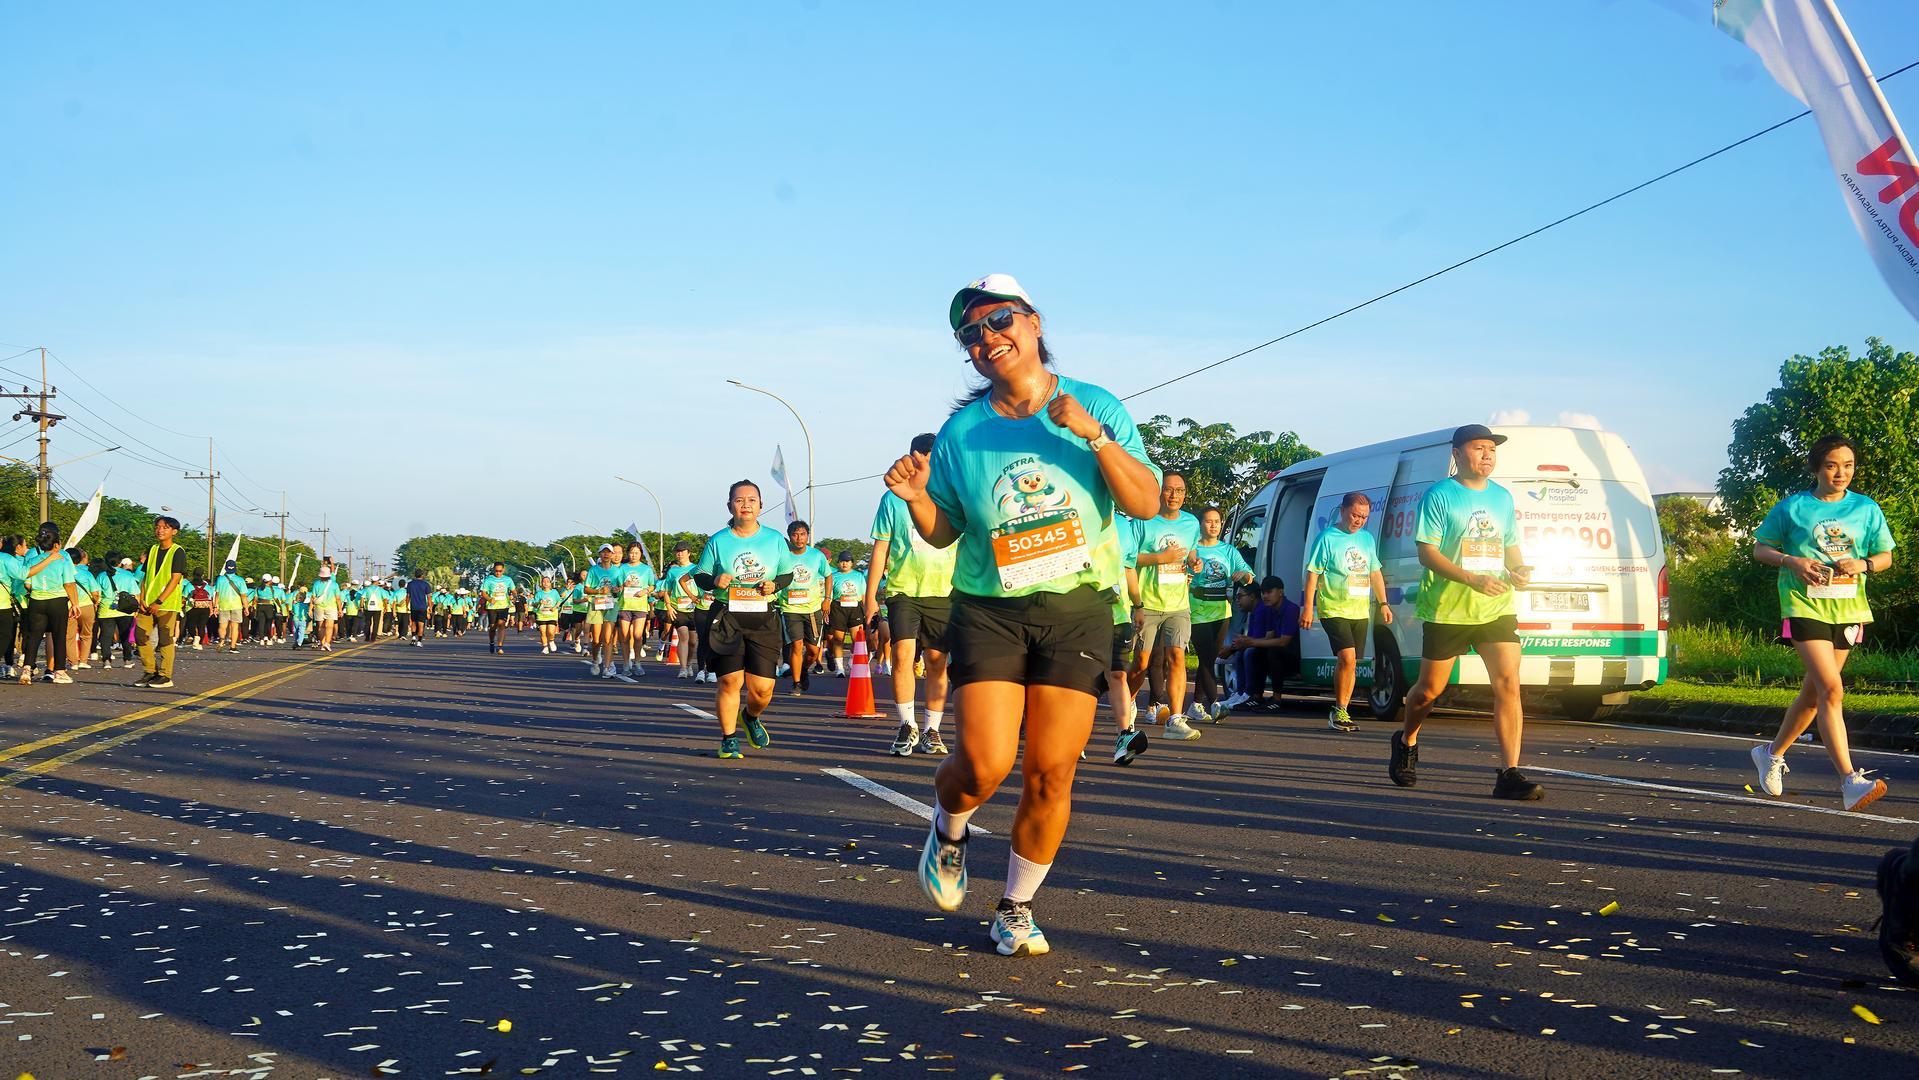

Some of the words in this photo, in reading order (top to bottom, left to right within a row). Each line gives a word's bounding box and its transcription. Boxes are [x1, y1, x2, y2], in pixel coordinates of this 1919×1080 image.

[1002, 456, 1035, 475] PETRA
[1548, 487, 1589, 495] mayapada
[1548, 494, 1577, 502] hospital
[1524, 512, 1583, 522] Emergency
[1584, 511, 1608, 521] 24/7
[1008, 527, 1067, 553] 50345
[1534, 638, 1559, 648] FAST
[1560, 638, 1613, 648] RESPONSE
